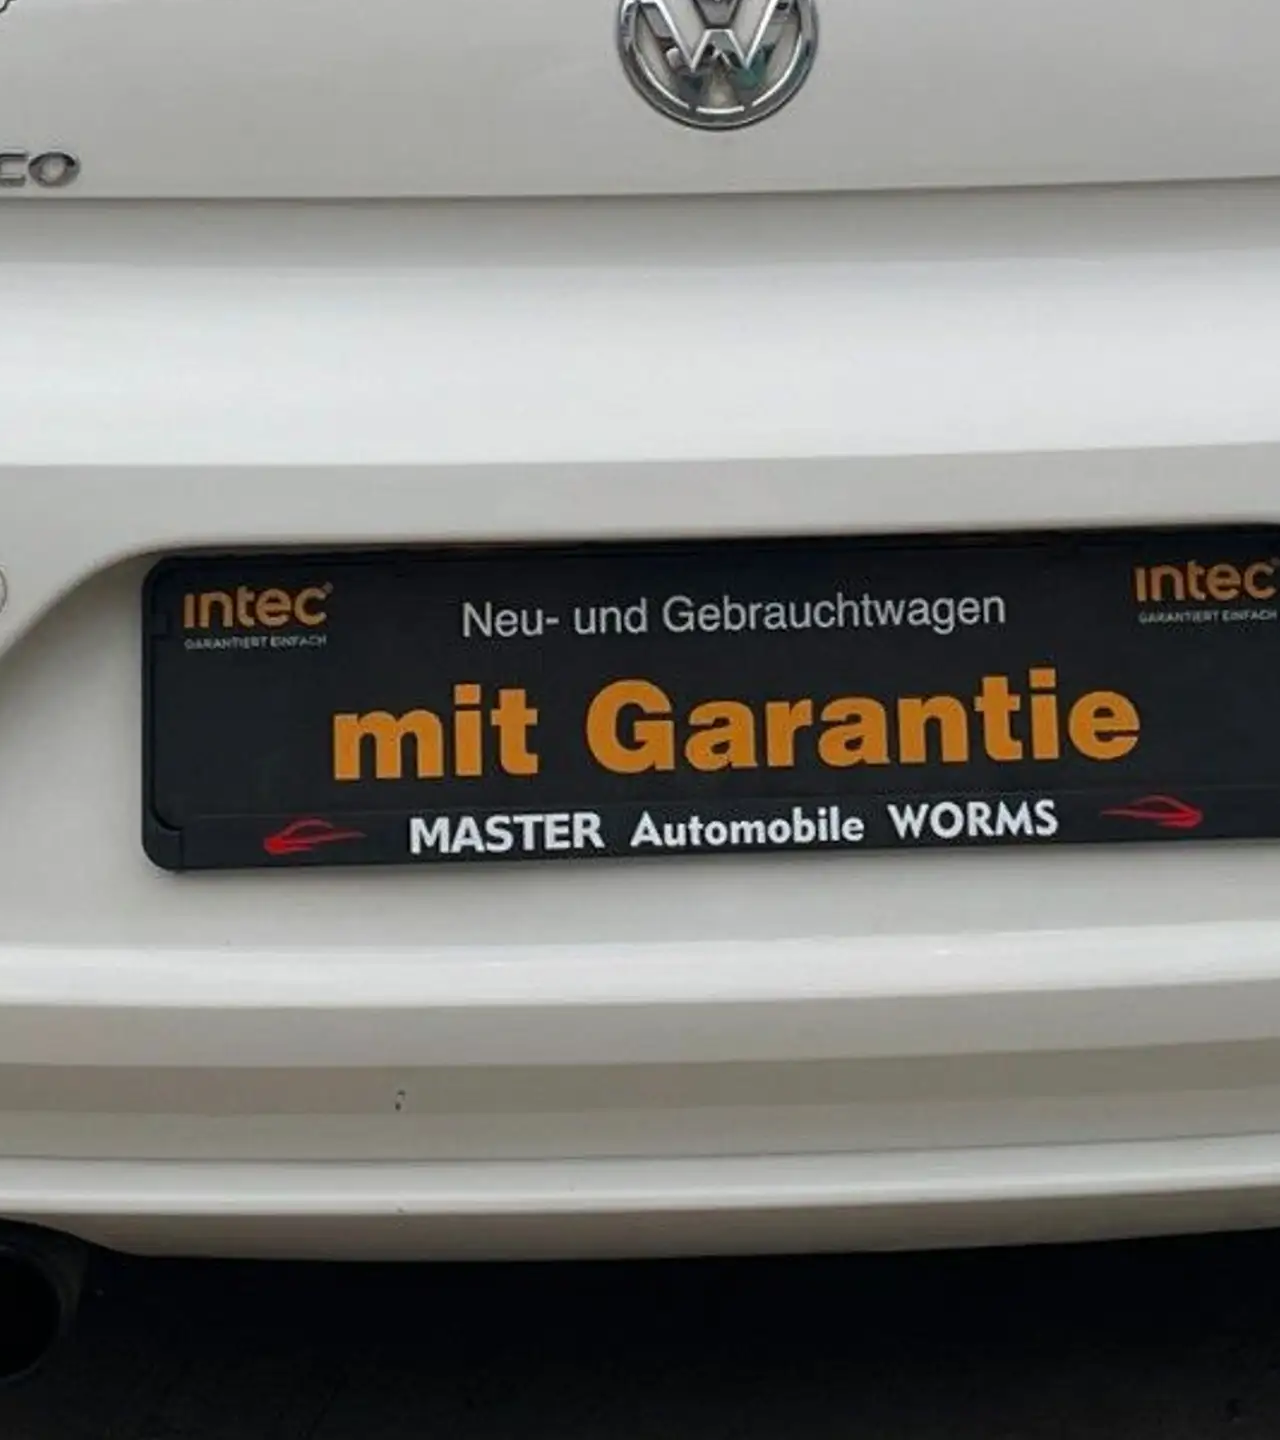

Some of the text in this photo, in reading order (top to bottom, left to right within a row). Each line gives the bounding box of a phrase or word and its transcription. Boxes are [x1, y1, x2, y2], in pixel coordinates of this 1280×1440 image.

[1135, 560, 1277, 602] intec
[183, 585, 328, 629] intec
[462, 591, 1007, 638] Neu- und Gebrauchtwagen
[332, 667, 1141, 781] mit Garantie
[410, 799, 1060, 855] MASTER Automobile WORMS
